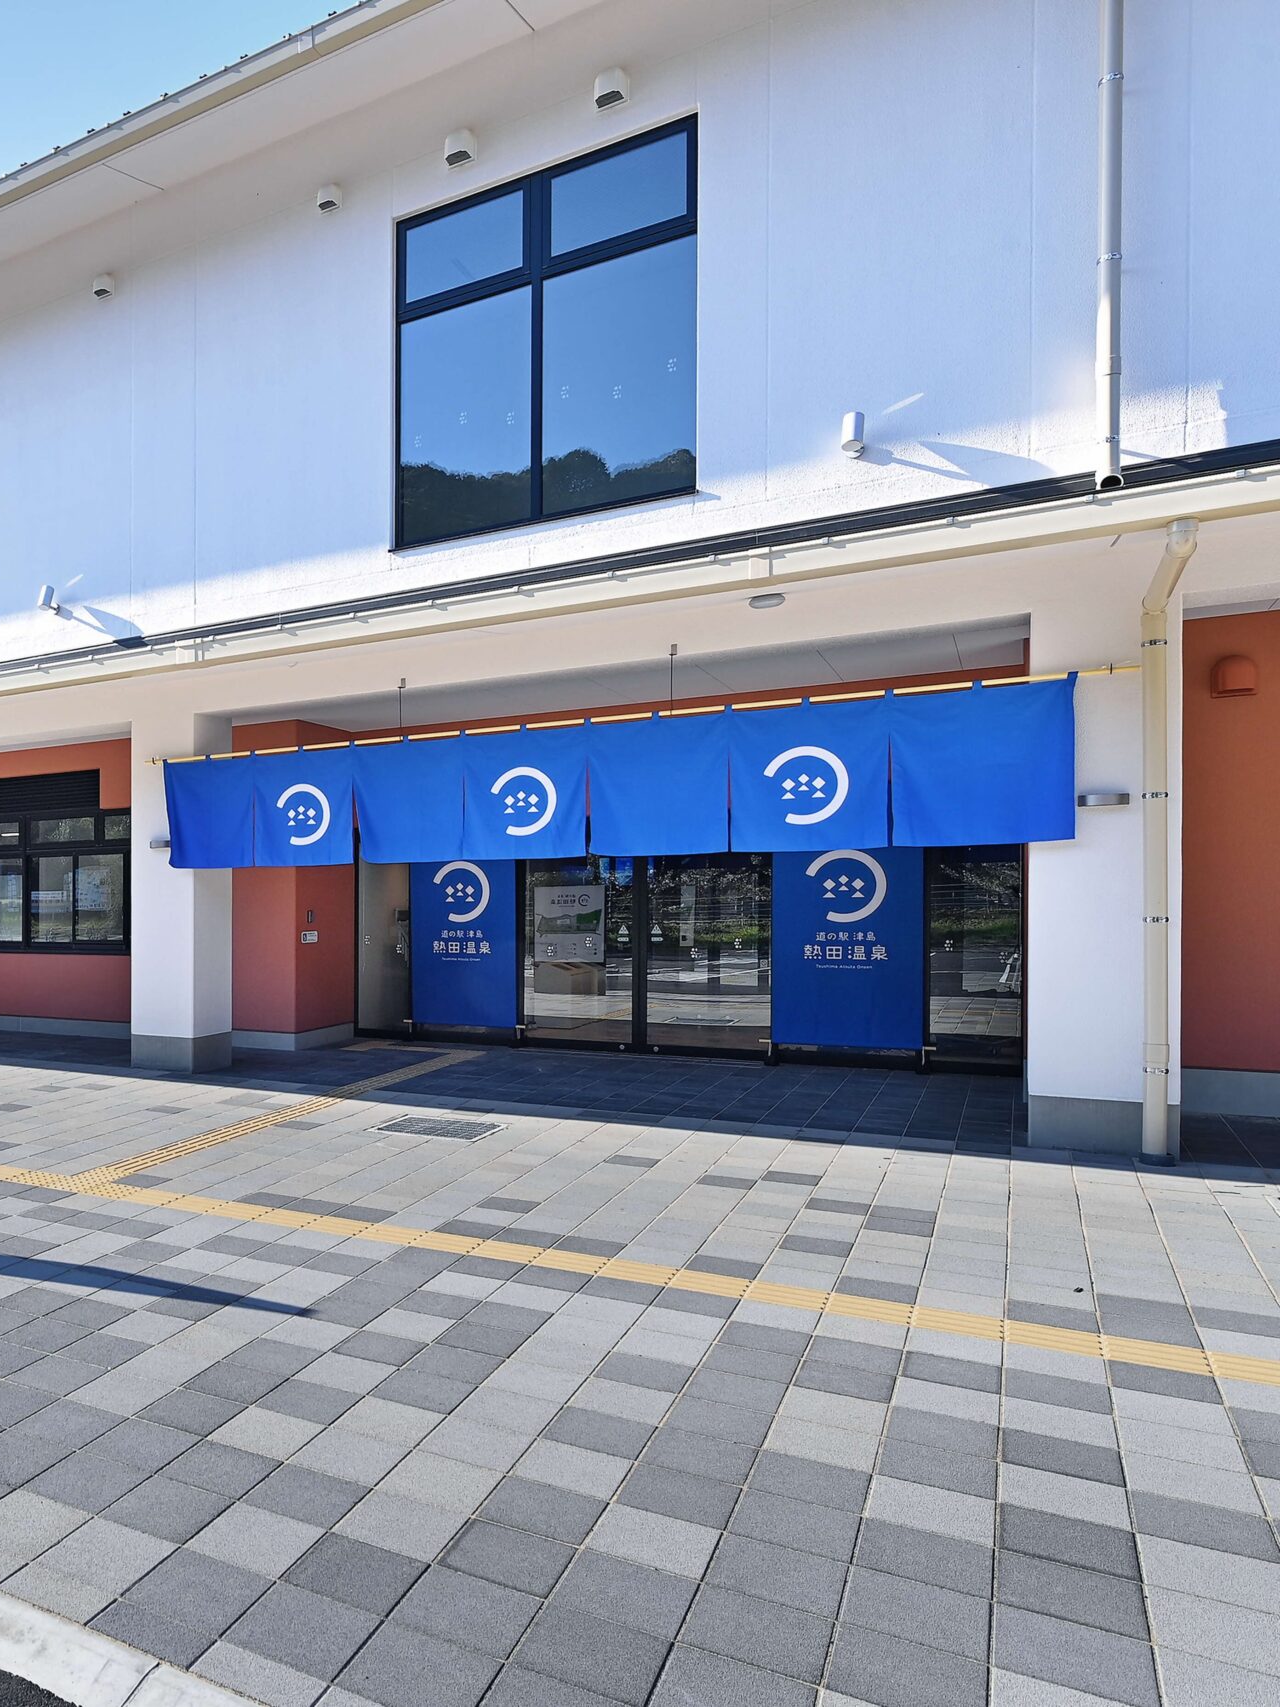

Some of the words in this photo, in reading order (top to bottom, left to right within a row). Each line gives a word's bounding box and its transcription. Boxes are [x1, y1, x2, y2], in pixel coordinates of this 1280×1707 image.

[441, 930, 465, 938] 道の駅
[816, 932, 849, 941] 道の駅
[853, 932, 876, 941] 津島
[433, 941, 491, 954] 熱田温泉
[804, 945, 888, 960] 熱田温泉
